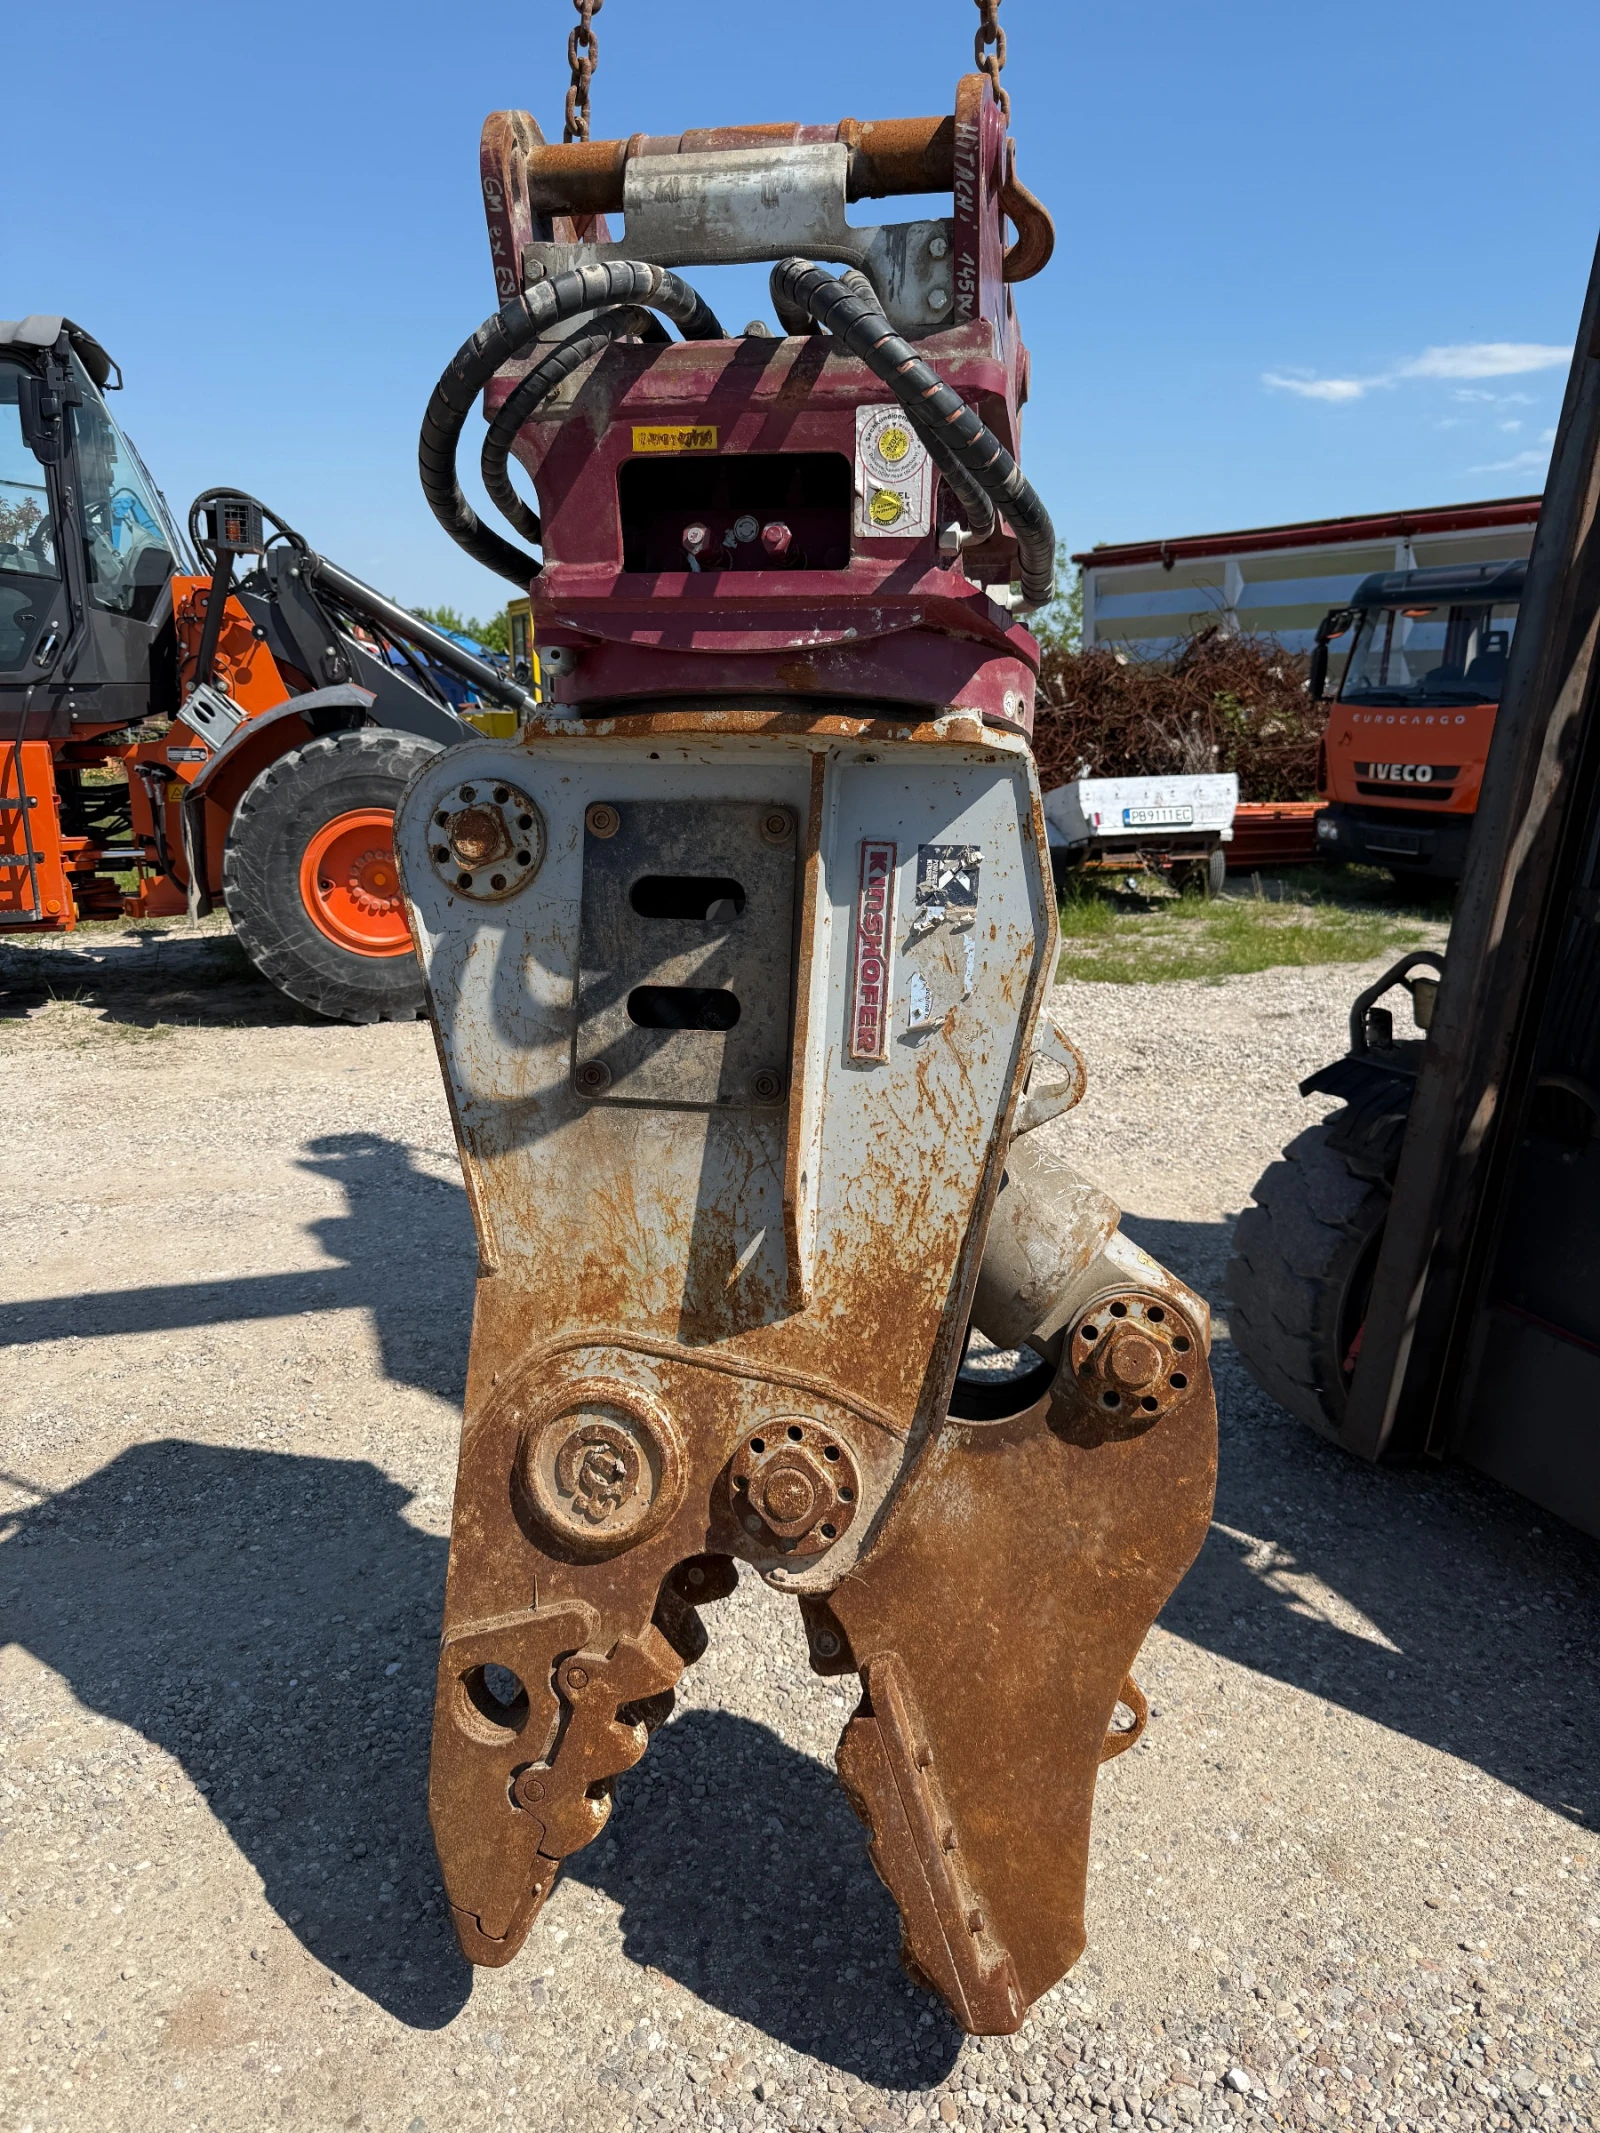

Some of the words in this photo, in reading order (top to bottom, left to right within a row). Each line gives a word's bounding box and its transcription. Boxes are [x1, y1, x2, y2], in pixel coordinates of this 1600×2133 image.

[483, 177, 503, 212] GM
[1353, 714, 1465, 725] EUROCARGO
[1368, 763, 1433, 783] IVECO
[858, 851, 888, 1052] KINSHOFER
